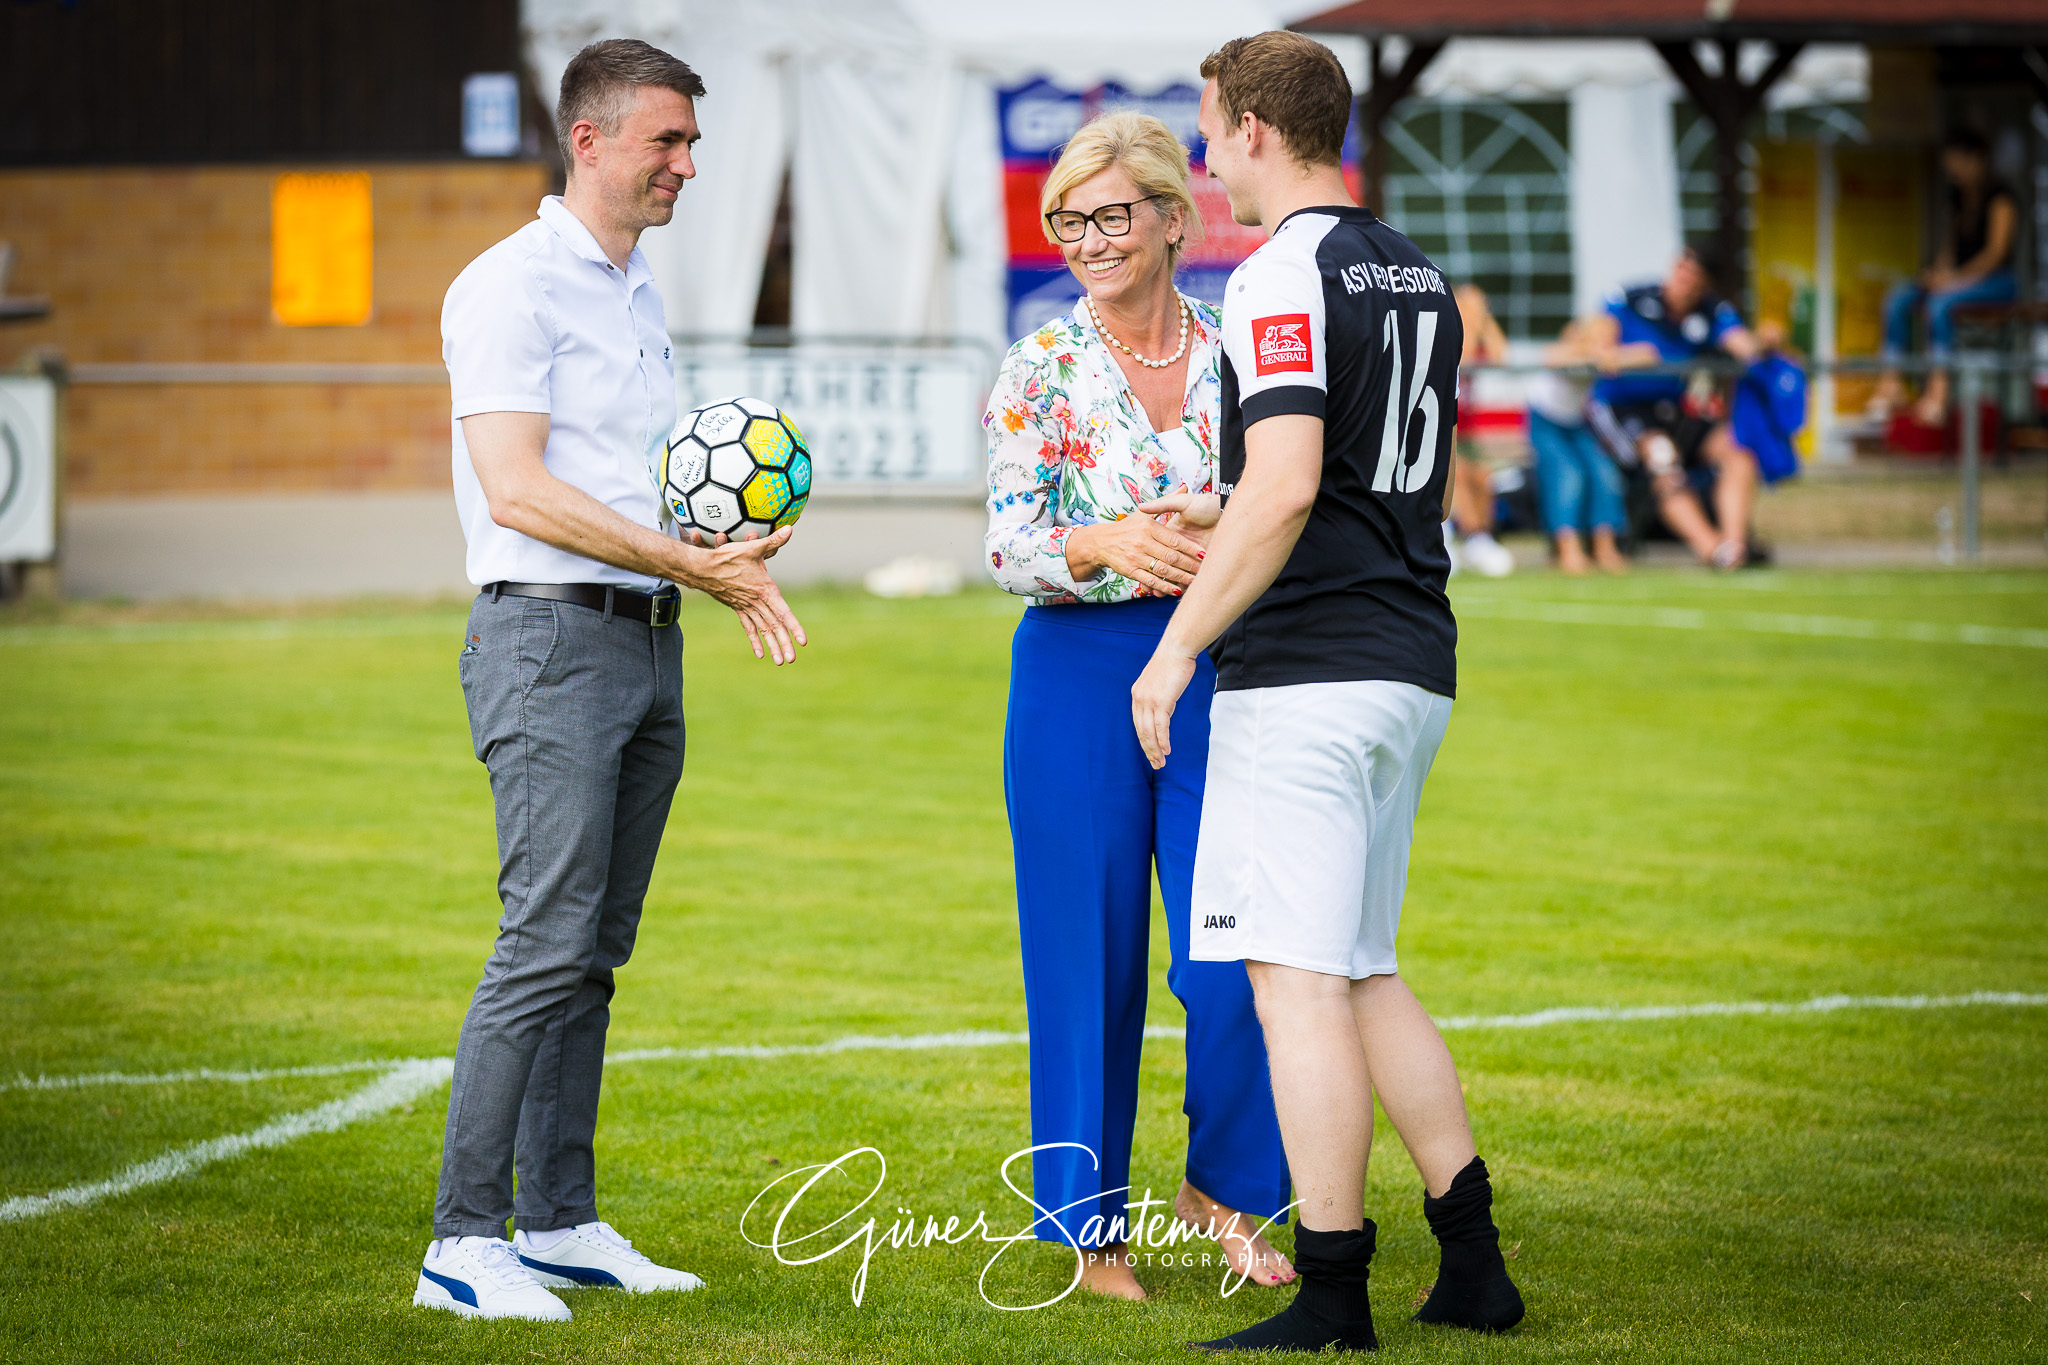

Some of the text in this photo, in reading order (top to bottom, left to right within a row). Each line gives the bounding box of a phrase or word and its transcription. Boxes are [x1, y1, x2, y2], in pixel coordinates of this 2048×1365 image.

[1341, 263, 1373, 294] ASV
[1261, 352, 1307, 365] GENERALI
[1371, 310, 1439, 493] 16
[1204, 915, 1236, 928] JAKO
